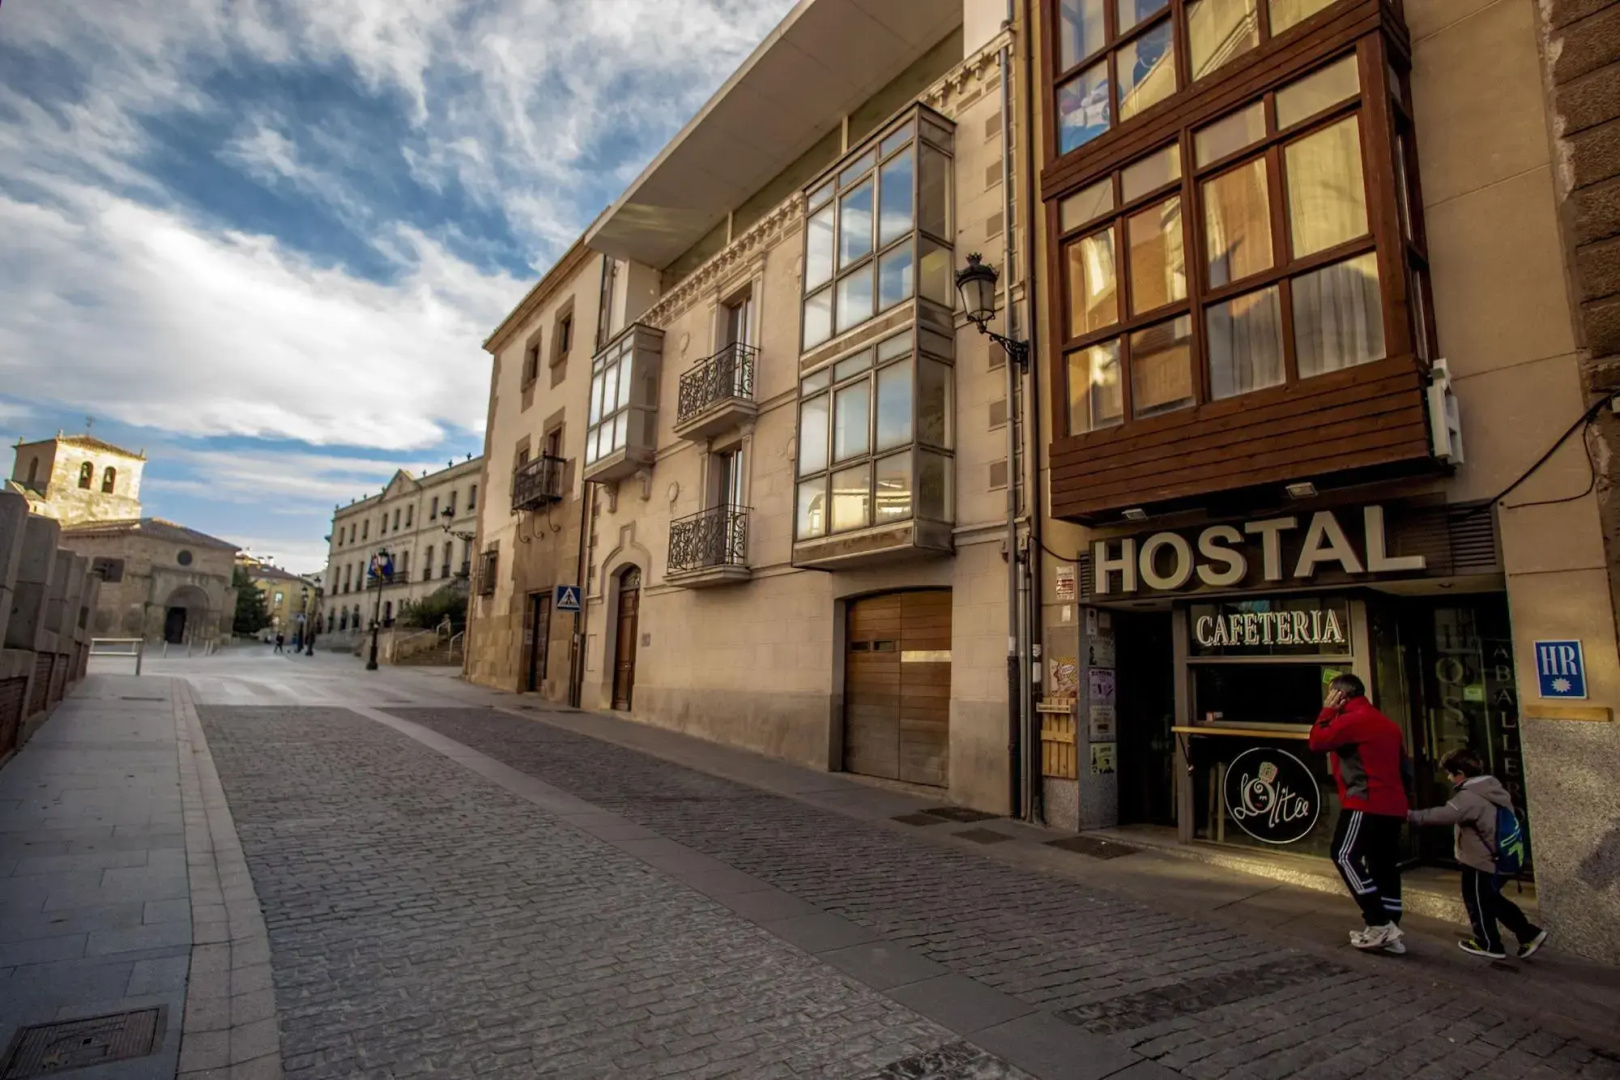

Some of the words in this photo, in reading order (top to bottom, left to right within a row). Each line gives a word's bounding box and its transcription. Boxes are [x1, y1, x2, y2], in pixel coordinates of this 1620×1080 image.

[1094, 504, 1427, 595] HOSTAL
[1195, 607, 1346, 647] CAFETERIA
[1539, 644, 1578, 676] HR
